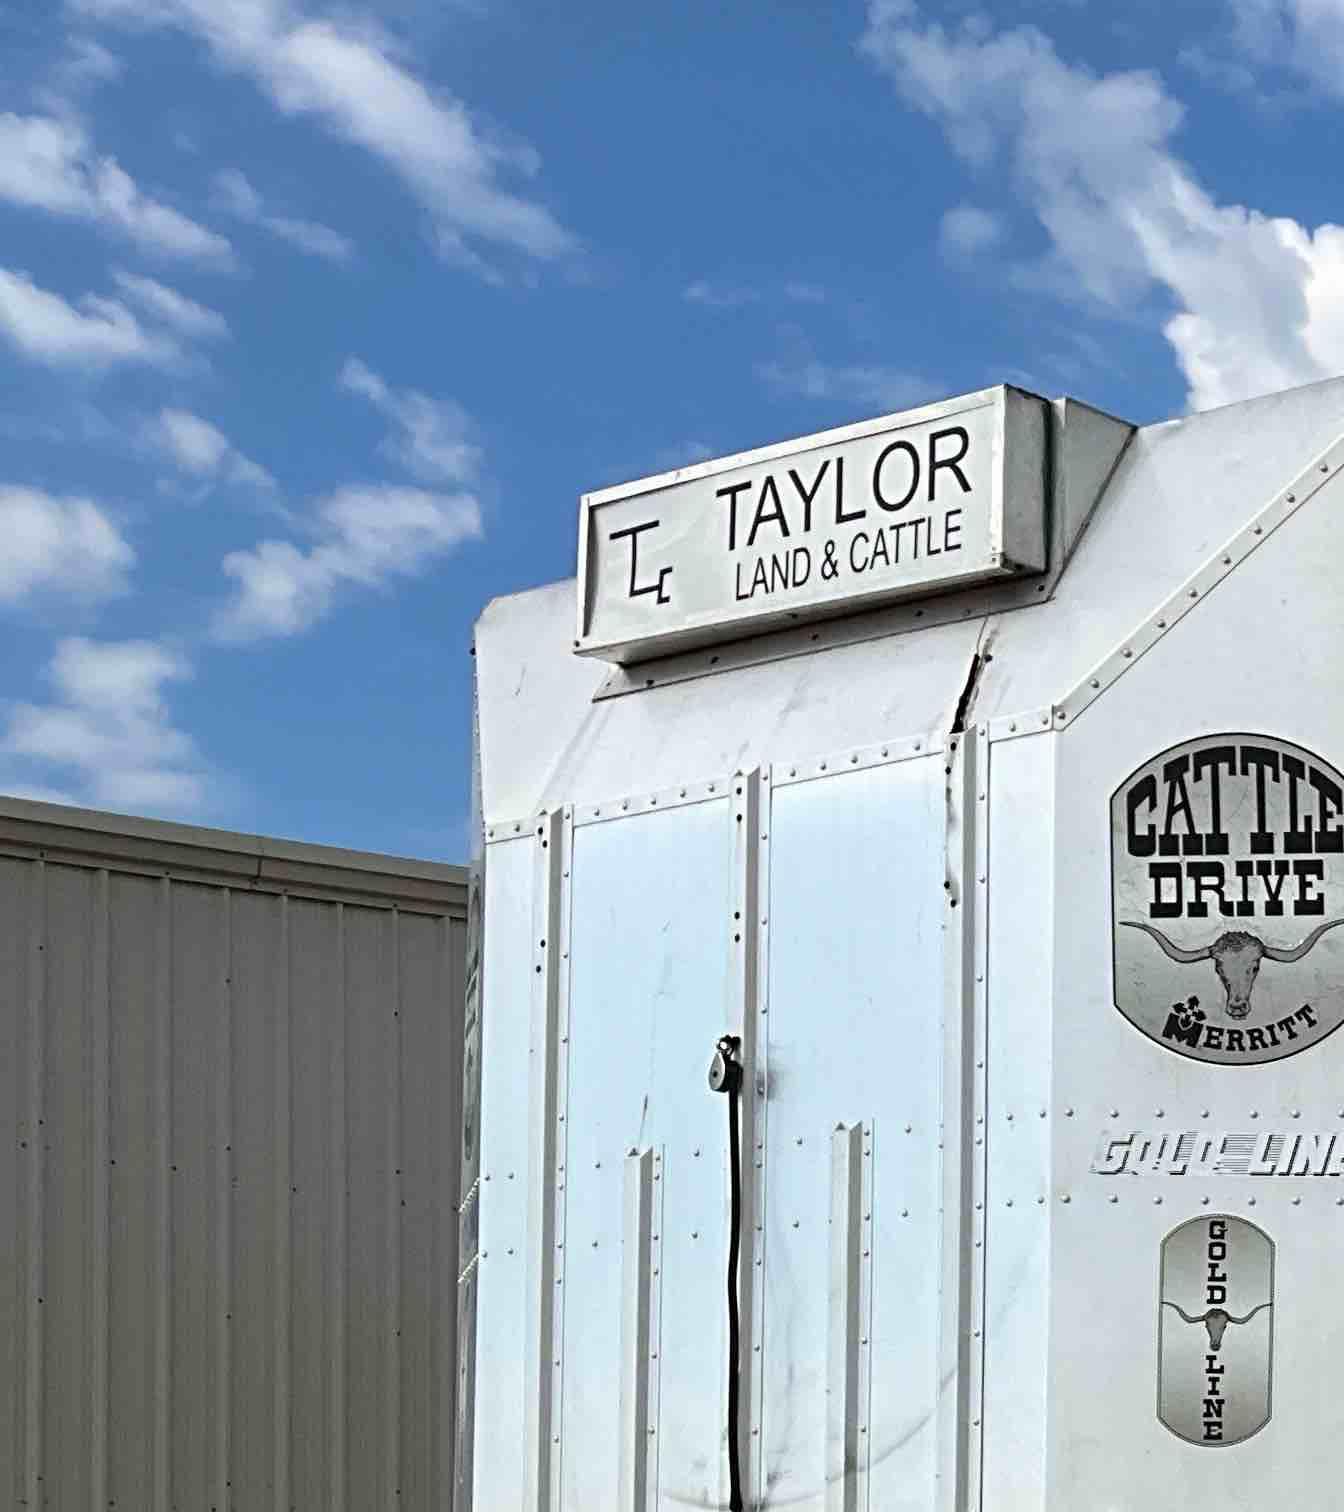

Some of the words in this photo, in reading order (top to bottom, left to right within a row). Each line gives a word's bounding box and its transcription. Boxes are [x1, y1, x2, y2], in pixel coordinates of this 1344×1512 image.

[716, 426, 972, 551] TAYLOR
[736, 547, 810, 601] LAND
[820, 539, 838, 580] &
[849, 509, 962, 574] CATTLE
[1126, 745, 1344, 857] CATTLE
[1148, 859, 1325, 918] DRIVE
[1162, 1003, 1318, 1052] MERRITT
[1206, 1220, 1228, 1305] GOLD
[1202, 1354, 1225, 1440] LINE
